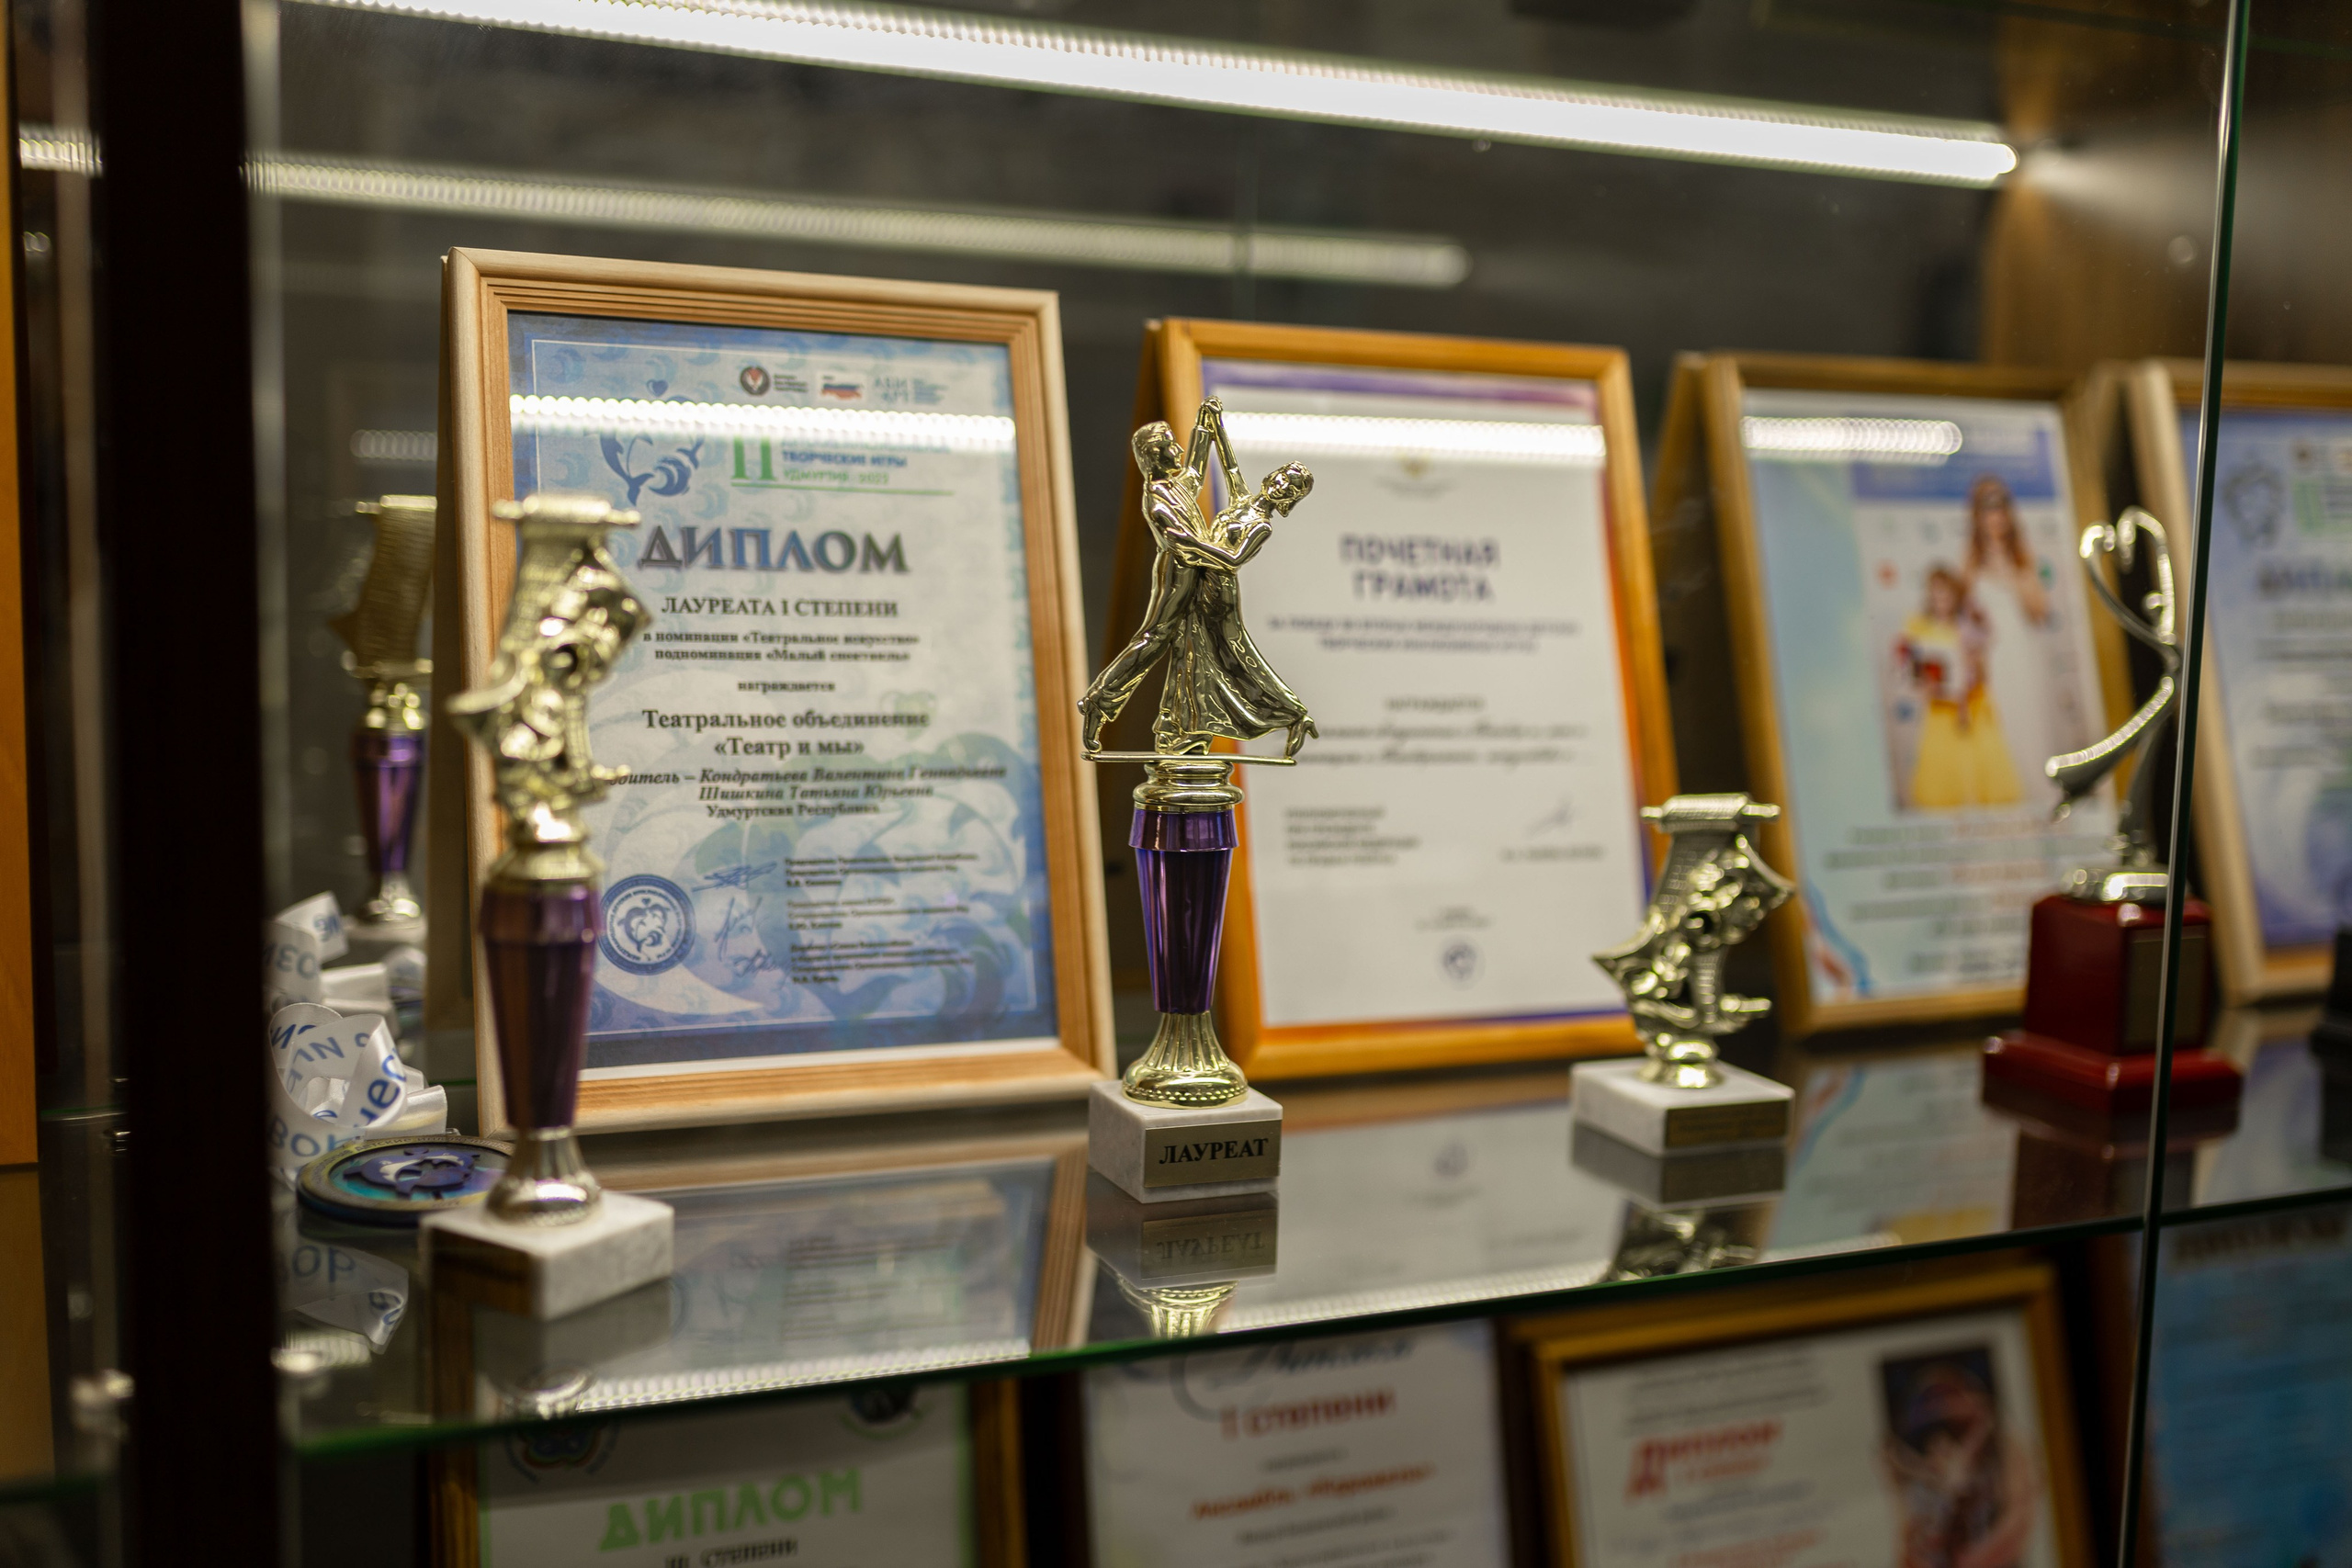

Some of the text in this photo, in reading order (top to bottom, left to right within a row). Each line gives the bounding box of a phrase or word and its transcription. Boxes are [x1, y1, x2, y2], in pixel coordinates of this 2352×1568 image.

[638, 525, 909, 573] ДИПЛОМ
[662, 596, 775, 615] ЛАУРЕАТА
[795, 600, 899, 617] СТЕПЕНИ
[655, 631, 739, 644] номинации
[654, 649, 762, 661] подноминация
[641, 709, 931, 733] Театральное объединение
[714, 738, 865, 760] «Театр и мы»
[699, 768, 808, 786] Кондратьева
[698, 786, 783, 800] Шишкина
[707, 805, 794, 820] Удмуртская
[1159, 1138, 1269, 1165] ЛАУРЕАТ
[598, 1467, 863, 1552] ДИПЛОМ
